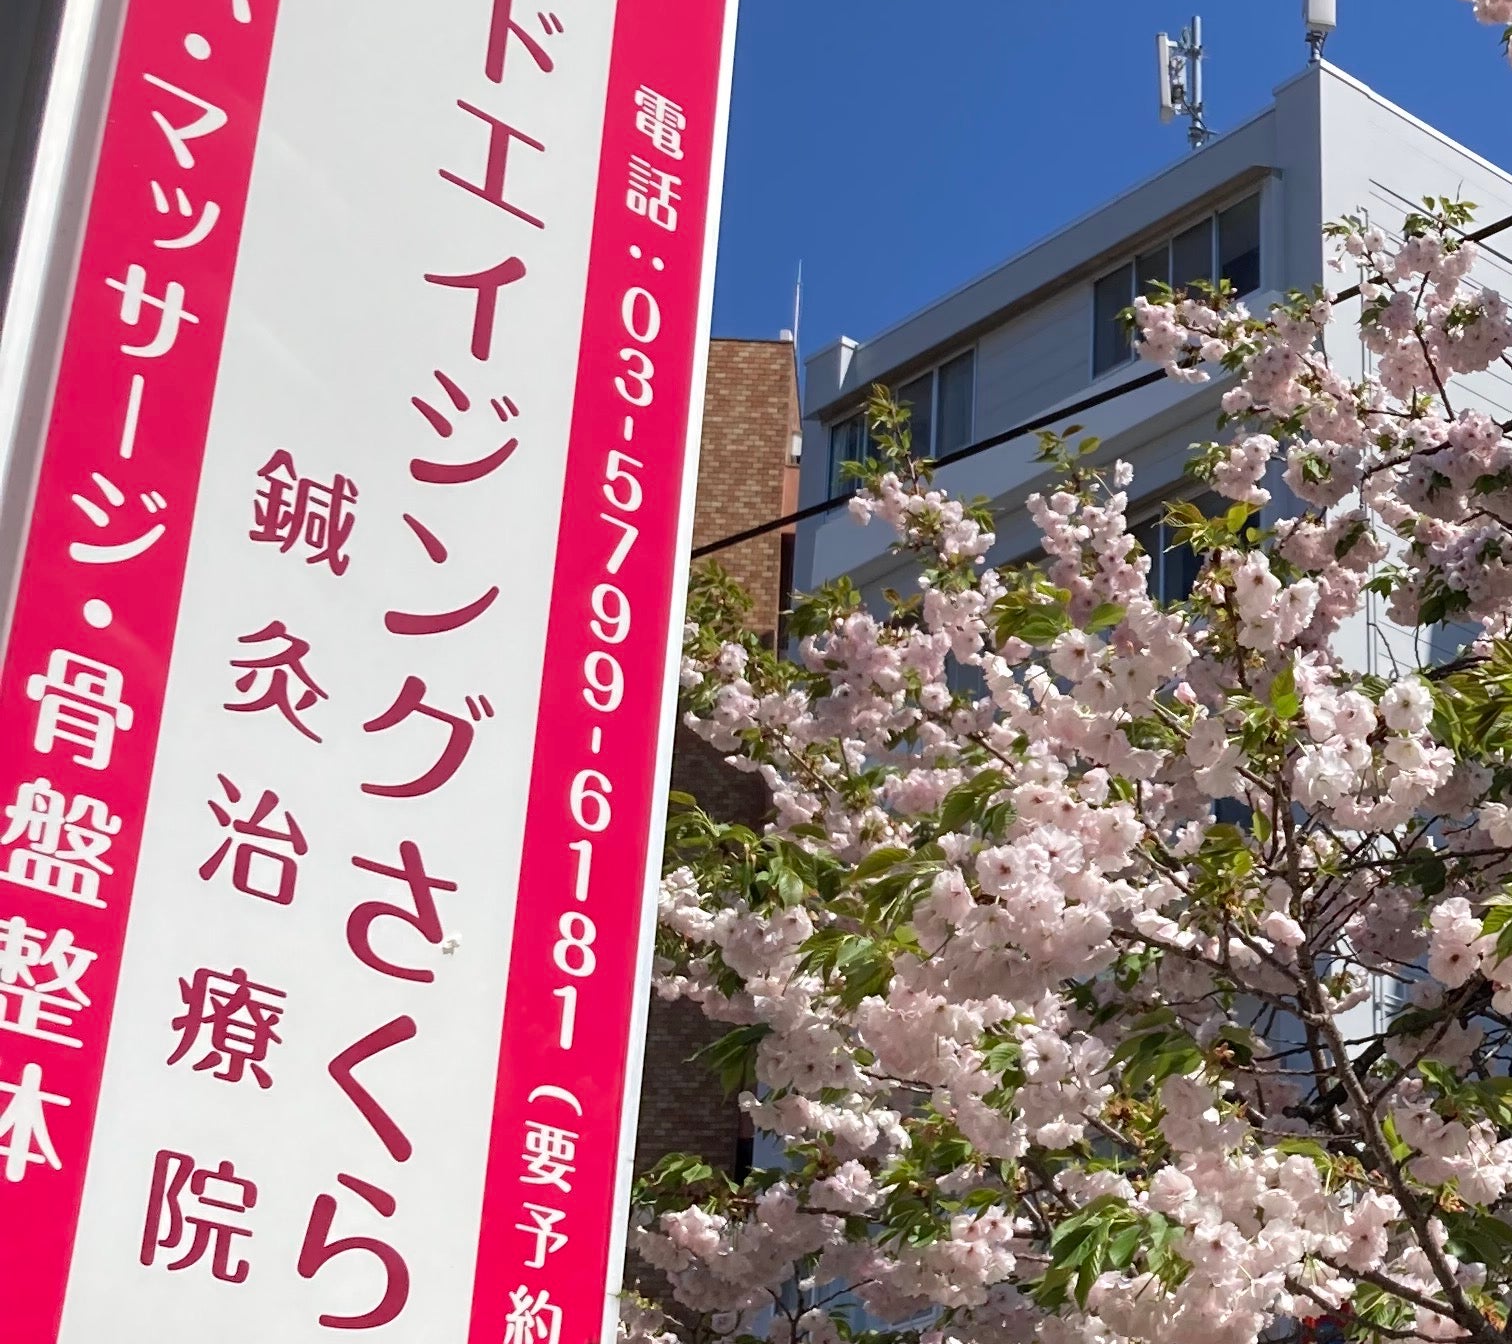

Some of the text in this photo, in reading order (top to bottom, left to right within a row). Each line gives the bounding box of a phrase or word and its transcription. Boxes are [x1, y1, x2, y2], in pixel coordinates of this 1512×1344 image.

[139, 449, 360, 1285] 鍼灸治療院
